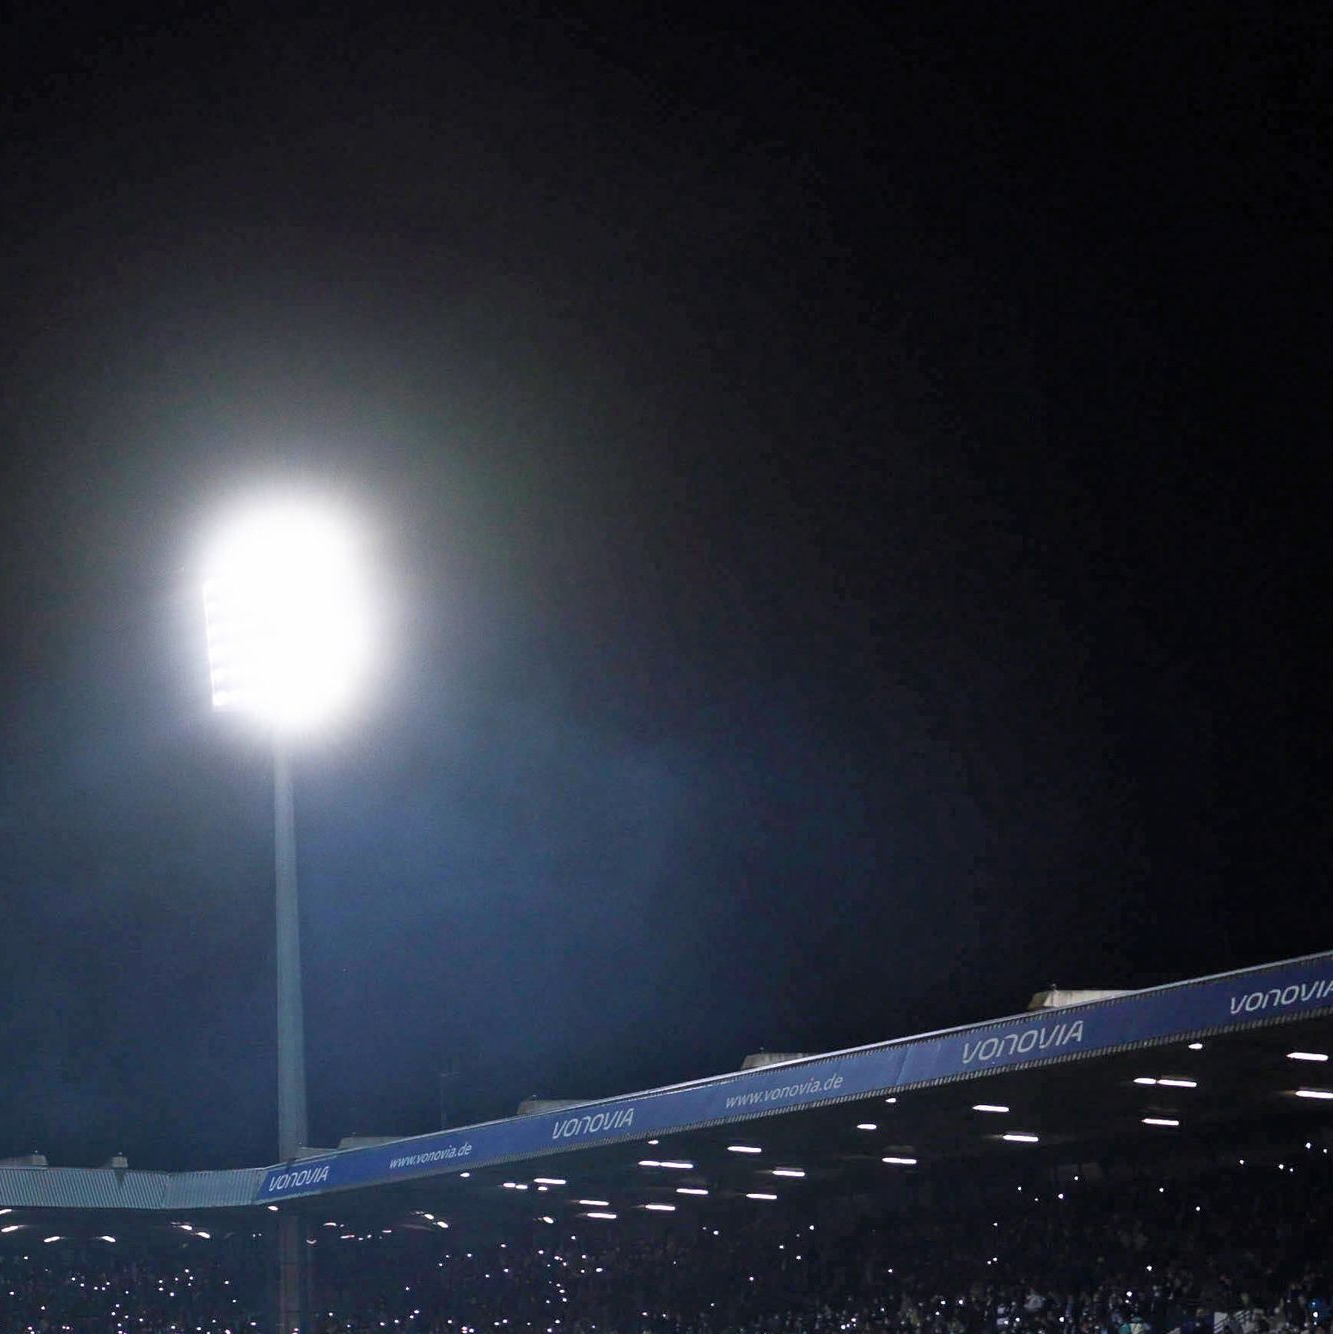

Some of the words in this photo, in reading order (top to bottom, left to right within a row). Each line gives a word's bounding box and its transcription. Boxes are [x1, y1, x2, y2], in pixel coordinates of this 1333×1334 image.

[962, 1019, 1084, 1064] VONOVIA
[725, 1072, 843, 1109] www.vonovia.de
[552, 1107, 634, 1139] VONOVIA
[389, 1141, 472, 1169] www.vonovia.de
[268, 1165, 330, 1192] VONOVIA
